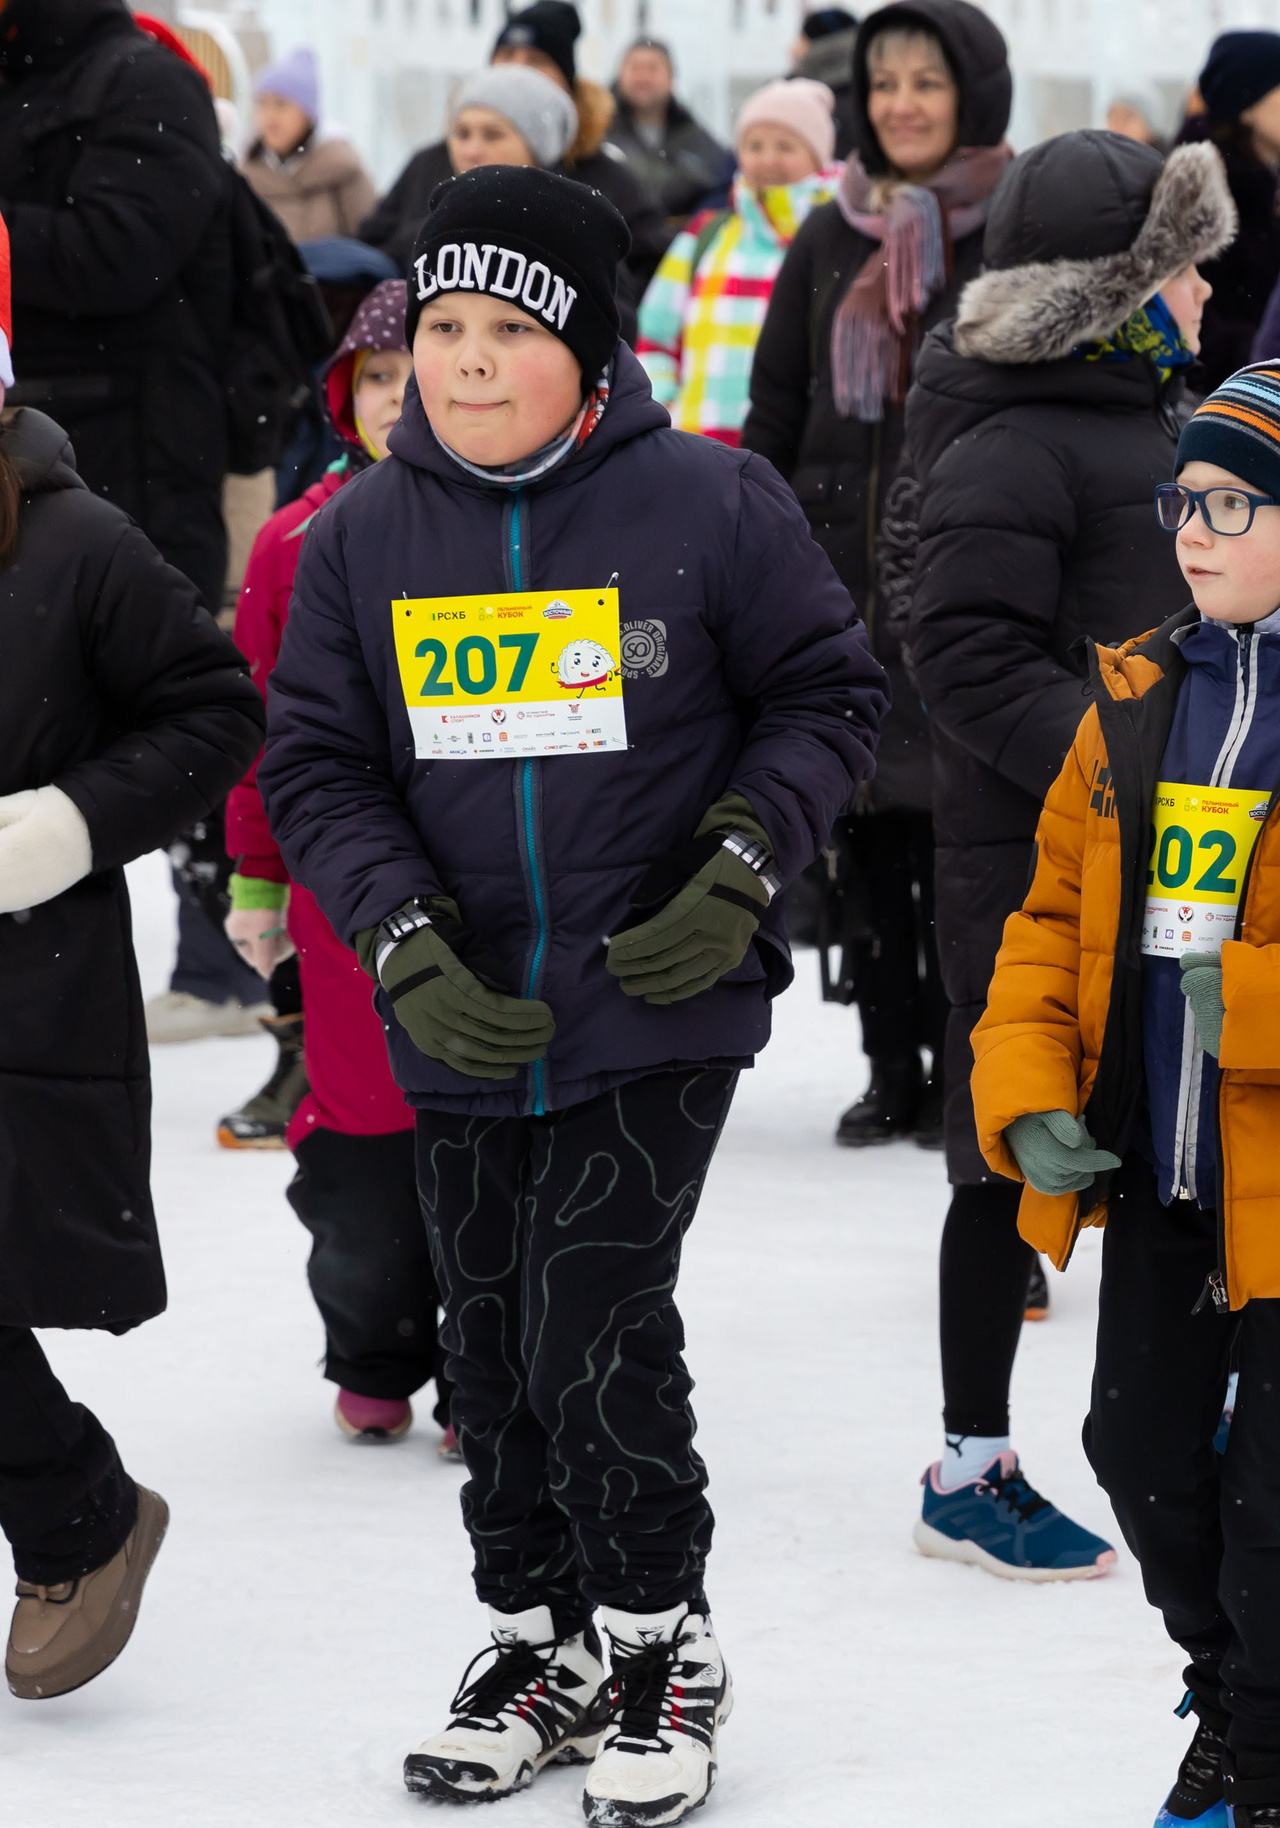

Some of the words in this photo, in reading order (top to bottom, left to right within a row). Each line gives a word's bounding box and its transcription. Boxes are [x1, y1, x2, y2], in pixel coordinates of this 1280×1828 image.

[414, 243, 577, 330] LONDON
[437, 611, 466, 620] РСХБ
[497, 611, 524, 619] КУБОК
[646, 630, 666, 676] ORIGINALS
[414, 632, 540, 697] 207
[621, 666, 638, 679] SPO
[1158, 797, 1175, 807] РСХБ
[1201, 799, 1239, 808] ПЕЛЬМЕННЫЙ
[1201, 806, 1229, 815] КУБОК
